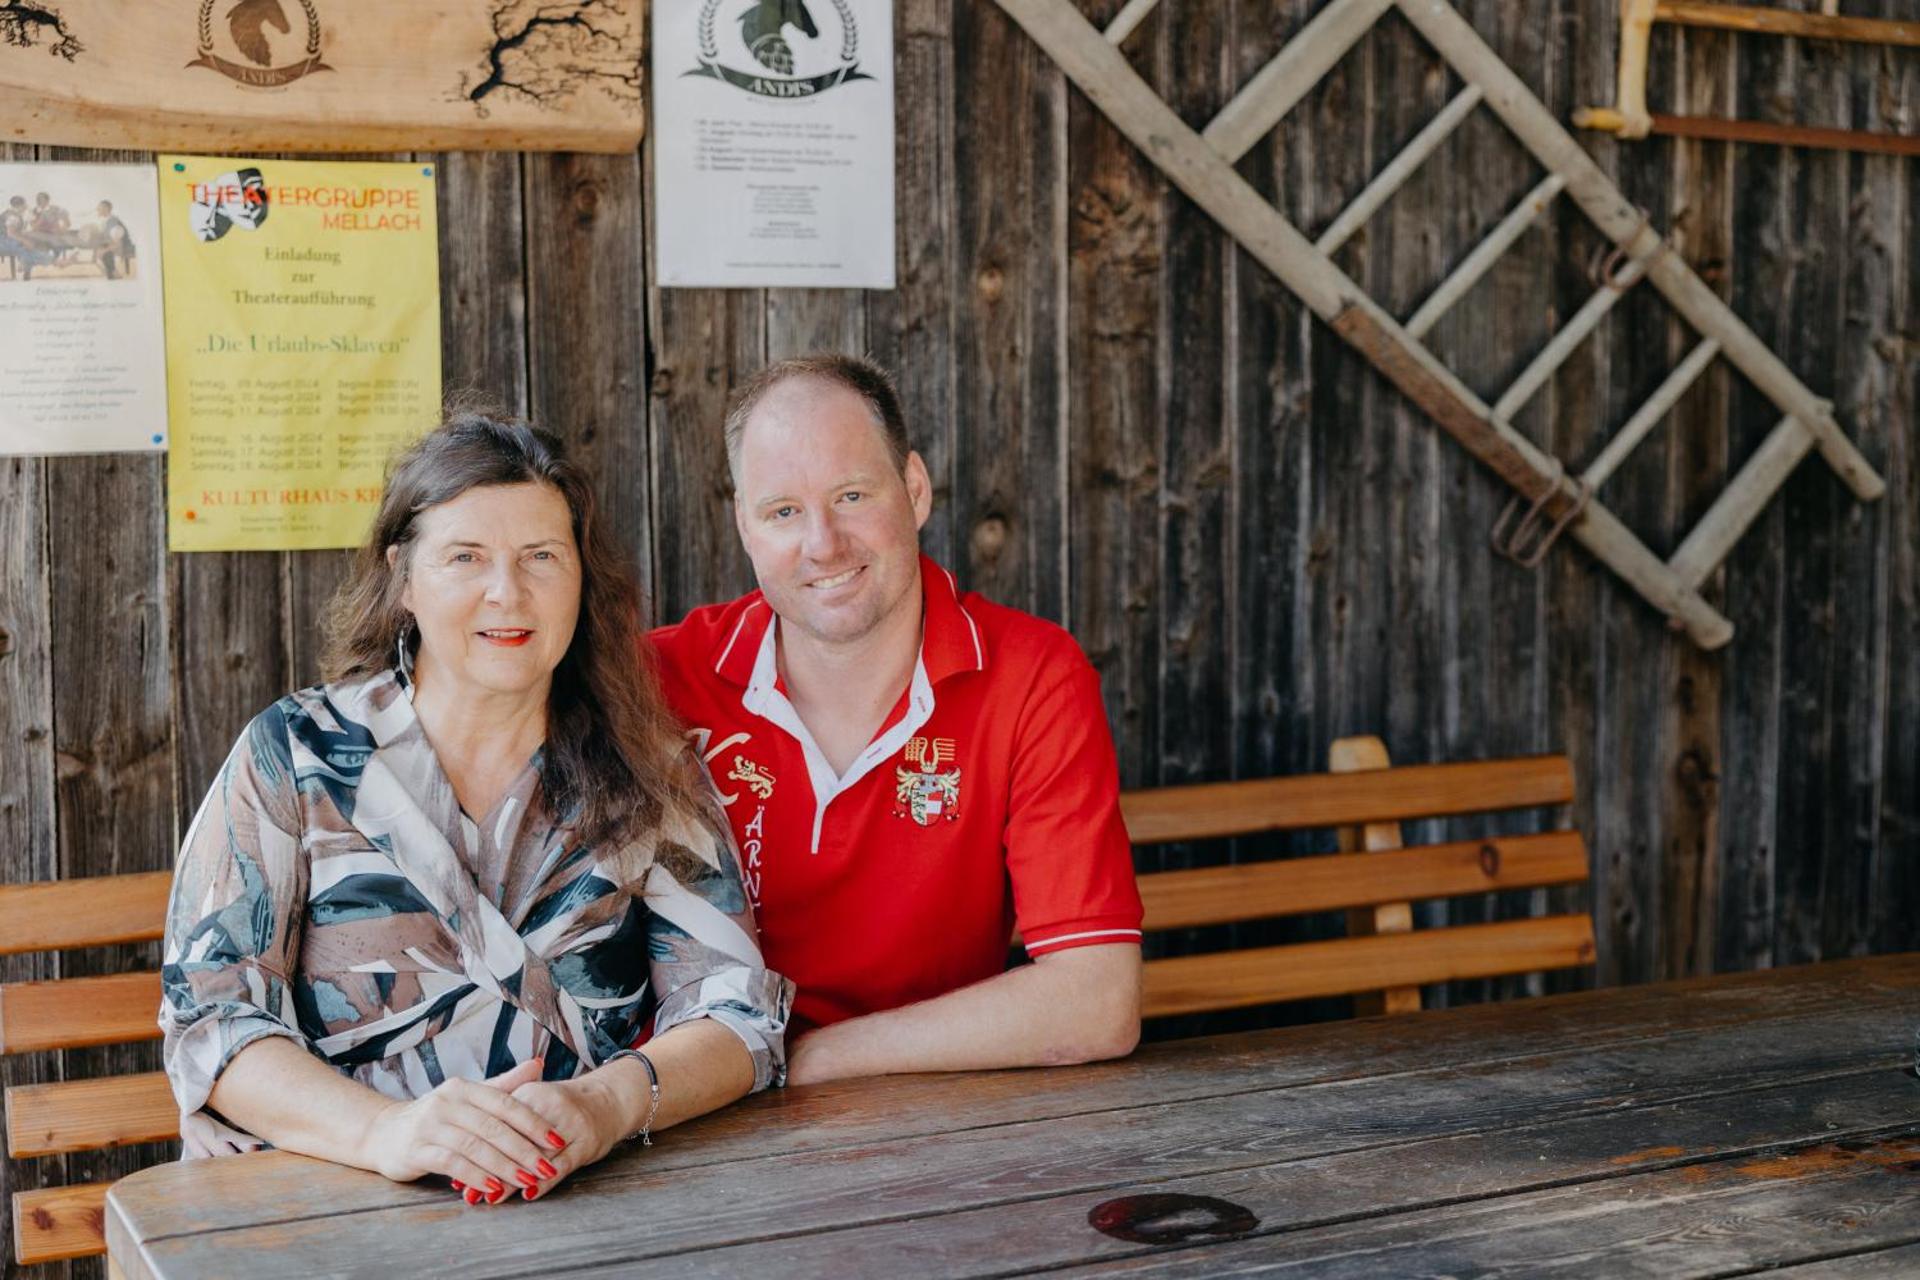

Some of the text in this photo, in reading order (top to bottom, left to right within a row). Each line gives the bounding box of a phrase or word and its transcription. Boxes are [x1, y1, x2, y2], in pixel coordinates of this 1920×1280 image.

[187, 183, 420, 209] THEATERGRUPPE
[322, 213, 421, 231] MELLACH
[264, 247, 342, 264] Einladung
[291, 272, 316, 284] zur
[231, 288, 376, 309] Theateraufführung
[202, 489, 349, 506] KULTURHAUS
